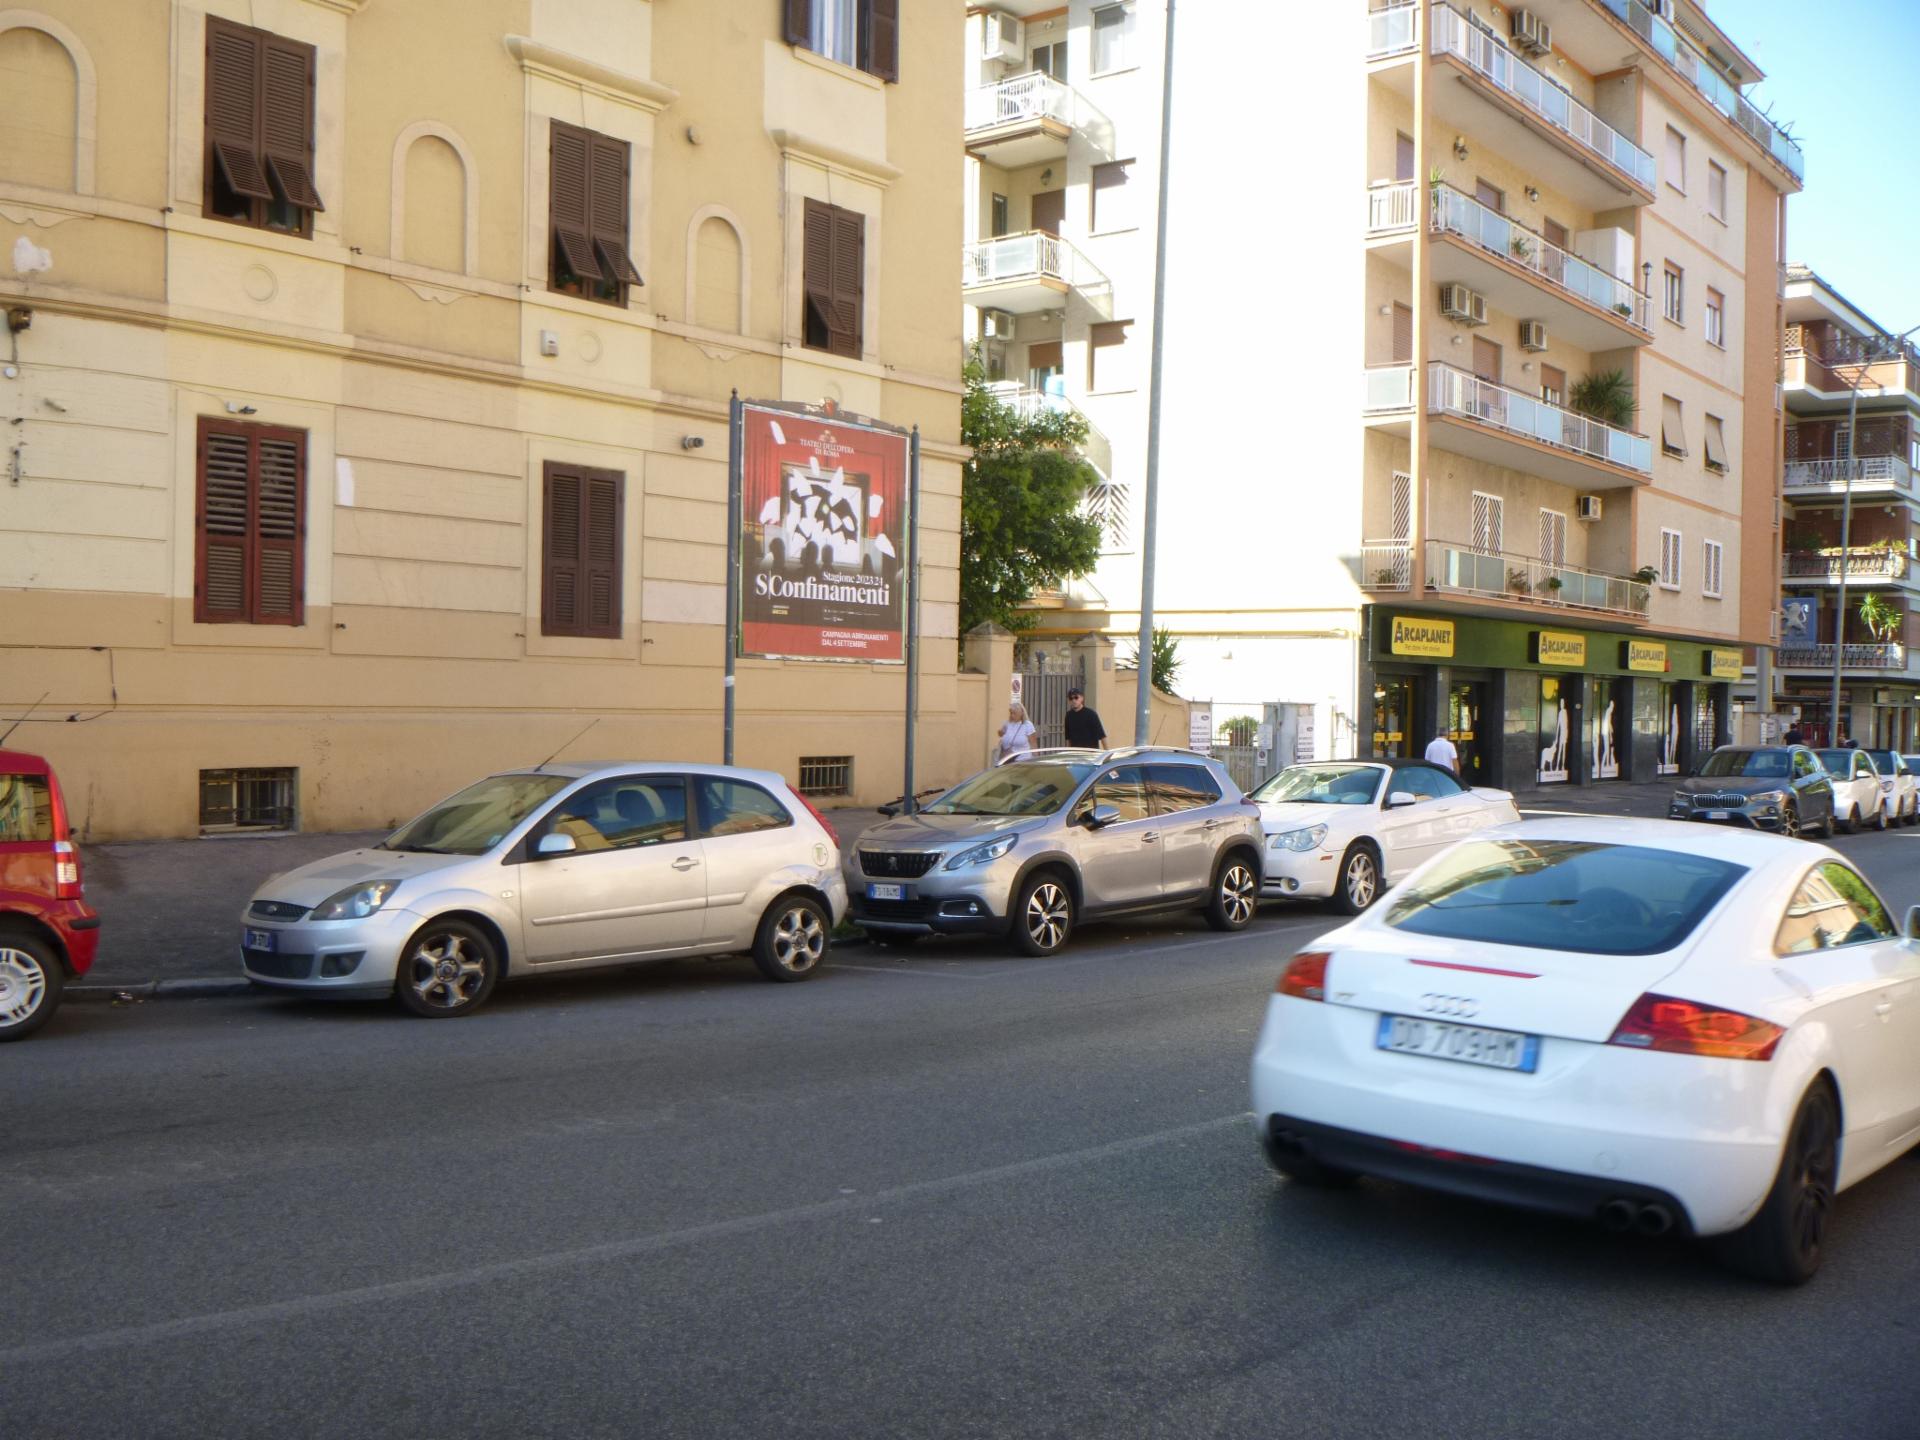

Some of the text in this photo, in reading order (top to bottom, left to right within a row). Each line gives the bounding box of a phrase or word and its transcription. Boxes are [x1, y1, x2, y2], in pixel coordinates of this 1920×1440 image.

[823, 571, 855, 584] Stagione
[1394, 621, 1451, 644] ARCAPLANET
[1541, 636, 1584, 655] ARCAPLANET
[1631, 645, 1664, 661] ARCAPLANET
